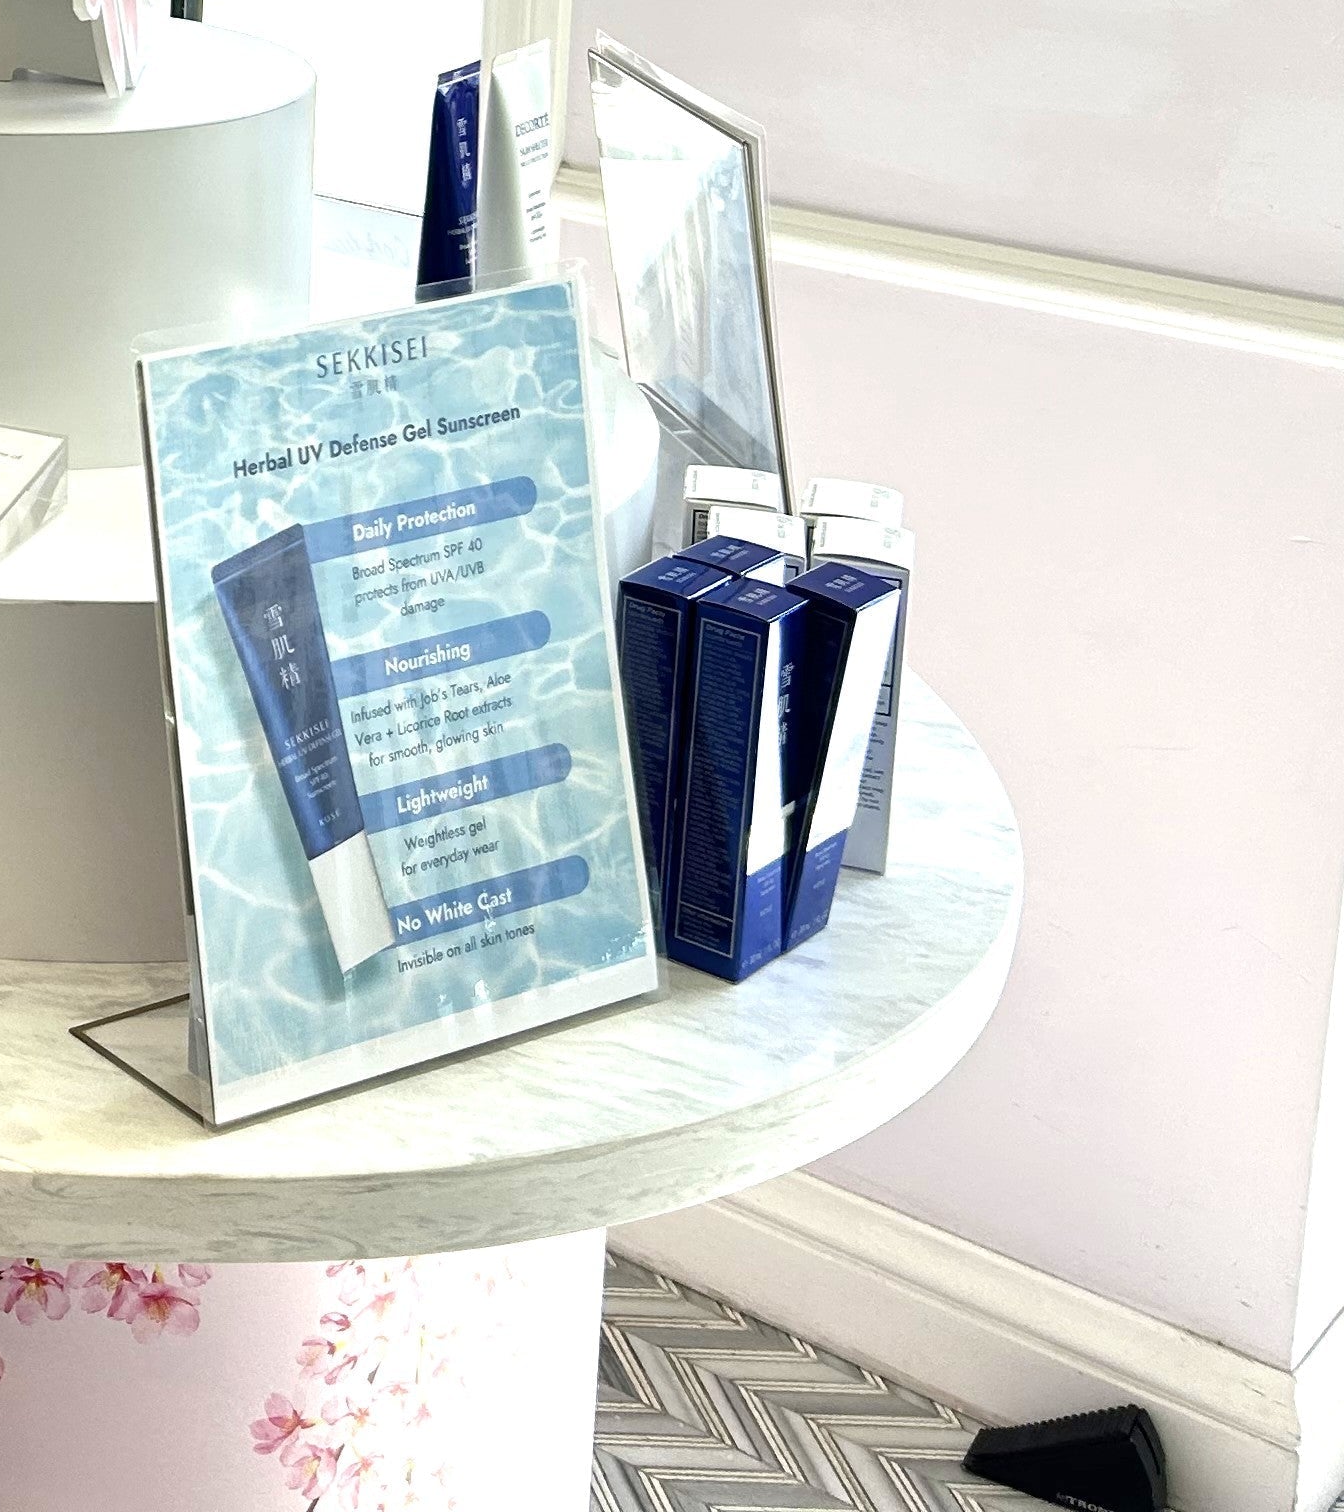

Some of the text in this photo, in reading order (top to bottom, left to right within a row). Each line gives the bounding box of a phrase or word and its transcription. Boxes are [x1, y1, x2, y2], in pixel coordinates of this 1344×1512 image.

[316, 336, 428, 378] SEKKISEI
[233, 406, 521, 478] Herbal UV Defense Gel Sunscreen
[353, 502, 477, 542] Daily Protection
[352, 538, 483, 580] Broad Spectrum SPF 40
[354, 561, 485, 607] protects from UVA/UVB
[401, 597, 445, 617] damage
[385, 643, 471, 676] Nourishing
[351, 672, 512, 724] Infused with Job's Tears, Aloe
[354, 696, 512, 747] Vera + Licorice Root extracts
[369, 721, 504, 767] for smooth, glowing skin
[397, 774, 489, 815] Lightweight
[404, 815, 487, 851] Weightless gel
[401, 840, 500, 877] for everyday wear
[397, 888, 512, 935] No White Cast
[398, 924, 535, 973] Invisible on all skin tones
